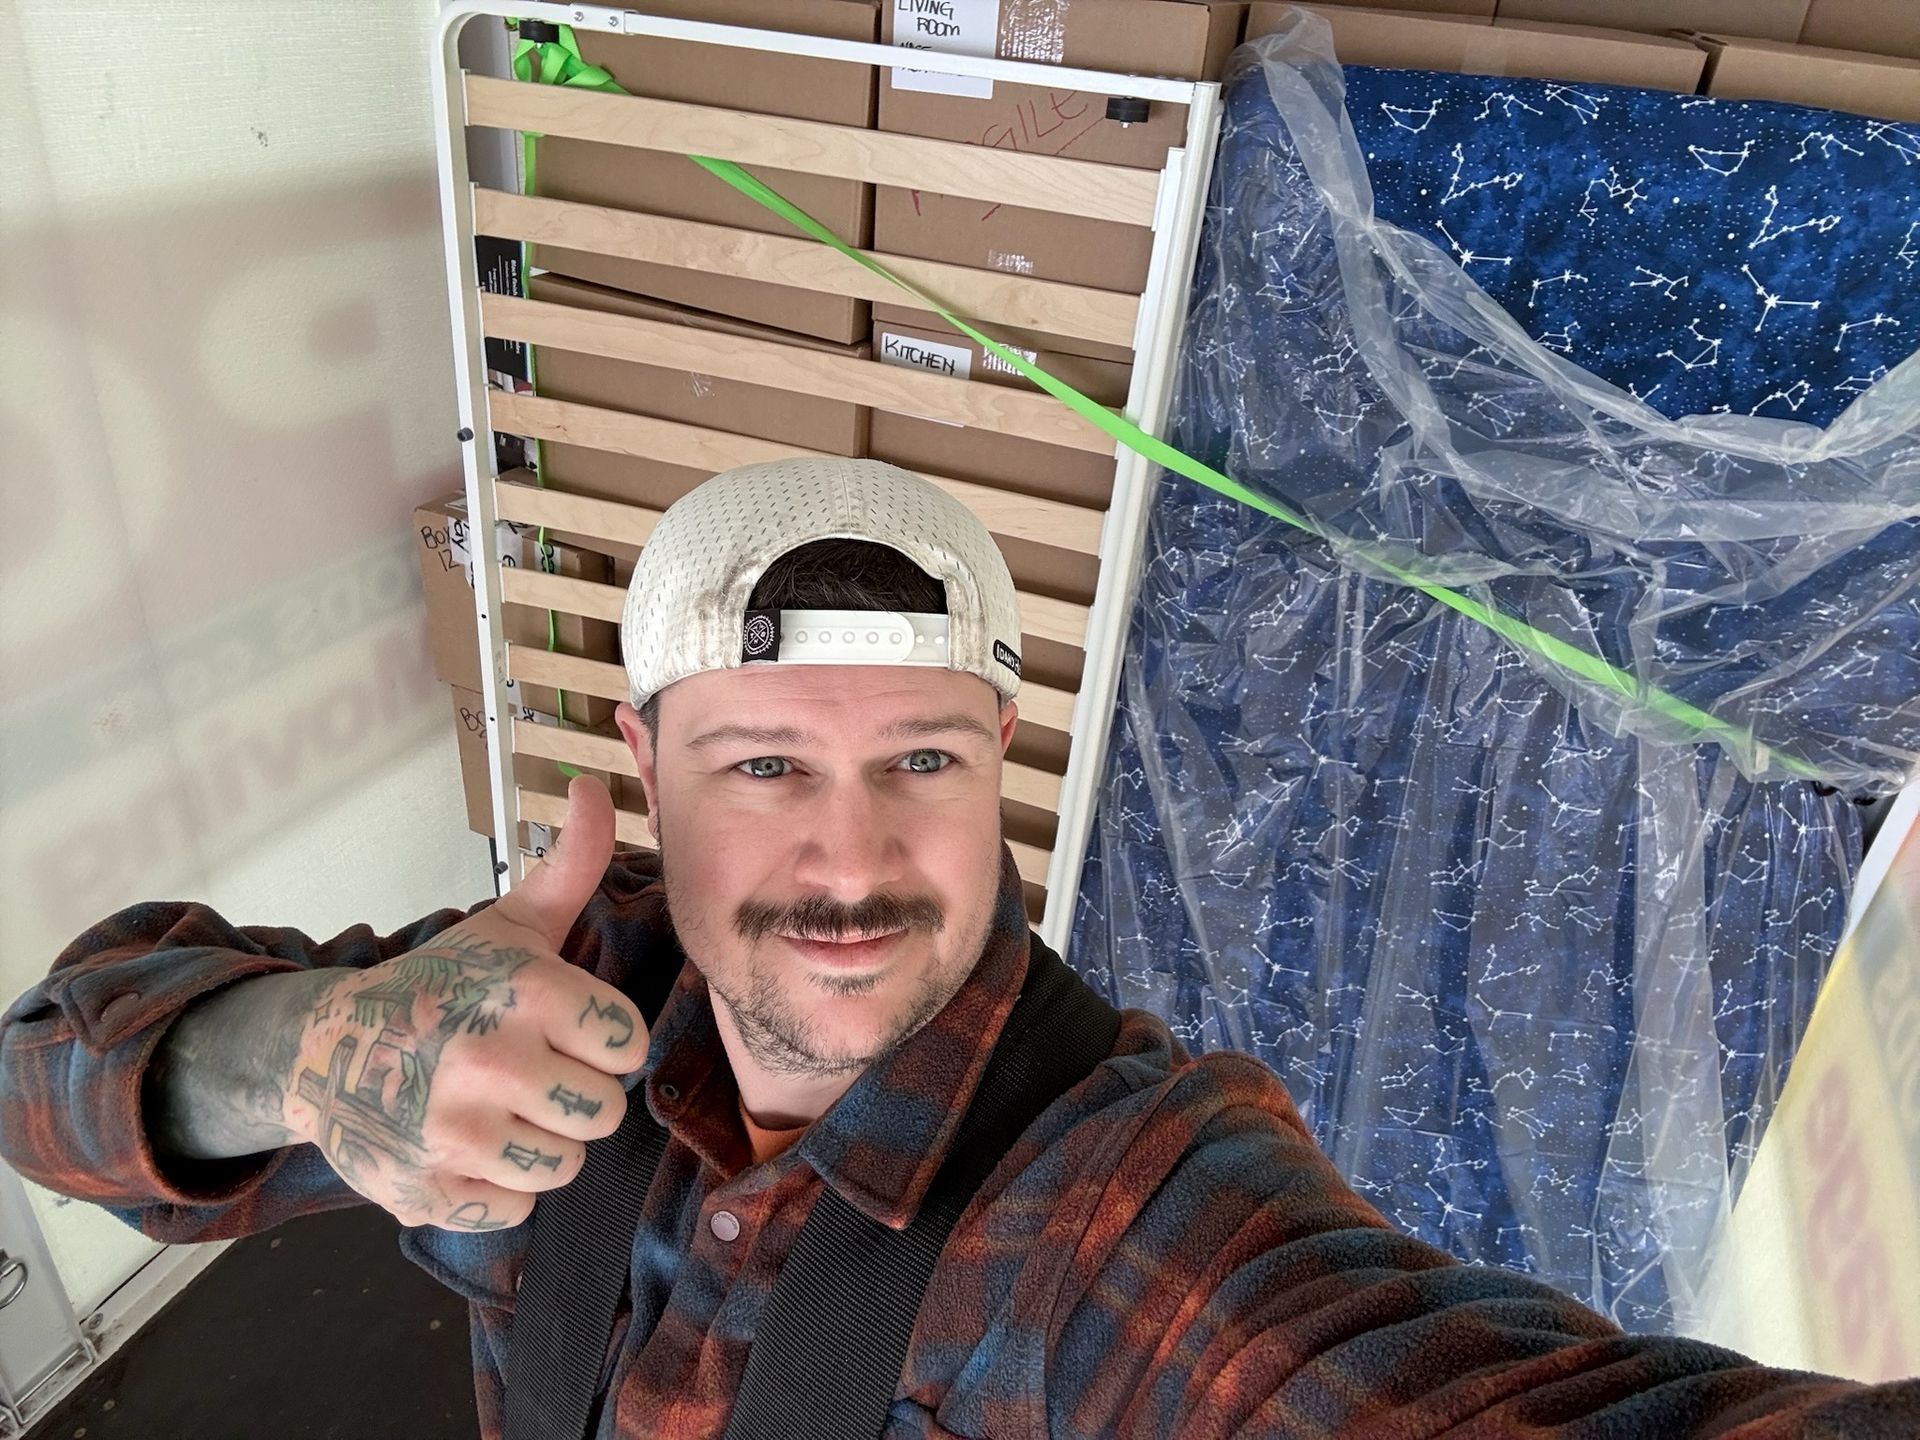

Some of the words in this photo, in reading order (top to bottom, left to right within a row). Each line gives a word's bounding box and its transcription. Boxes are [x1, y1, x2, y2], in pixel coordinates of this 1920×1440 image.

[898, 0, 954, 20] LIVING
[885, 335, 955, 376] KITCHEN
[438, 549, 460, 572] 12
